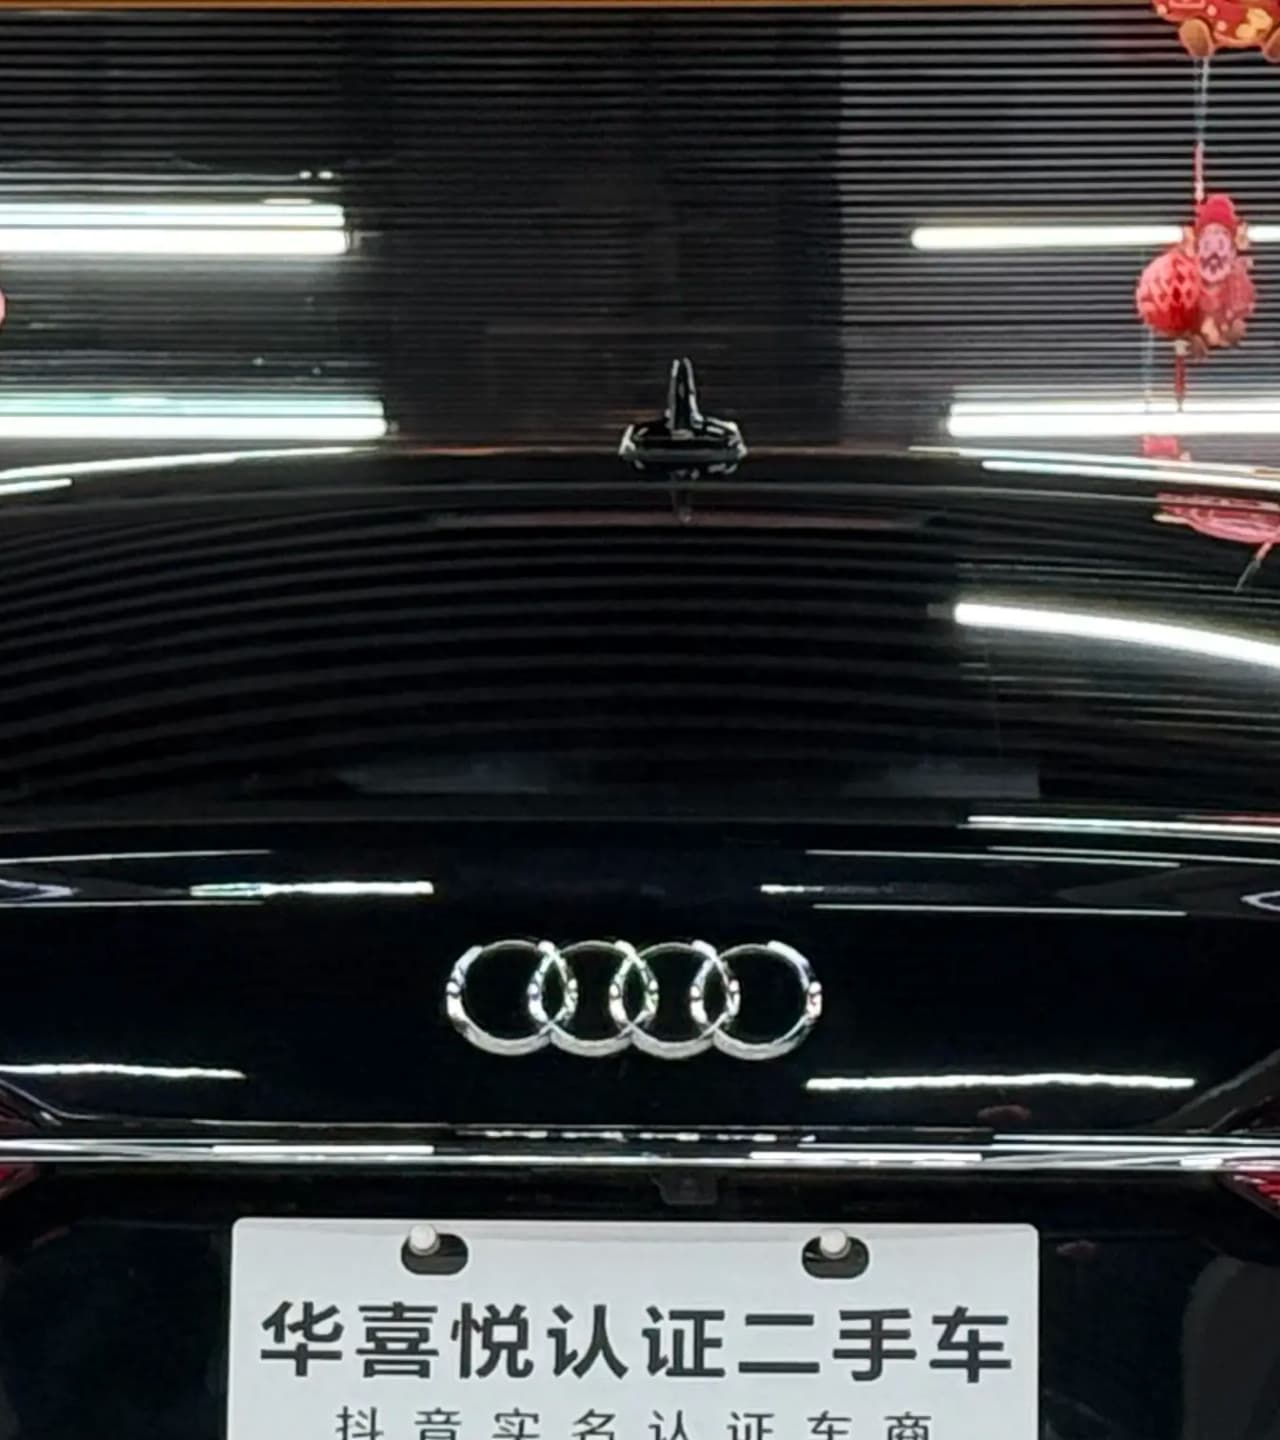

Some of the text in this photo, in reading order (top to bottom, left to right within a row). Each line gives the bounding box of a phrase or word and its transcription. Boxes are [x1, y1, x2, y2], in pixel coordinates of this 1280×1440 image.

[259, 1300, 1014, 1384] 华喜悦认证二手车
